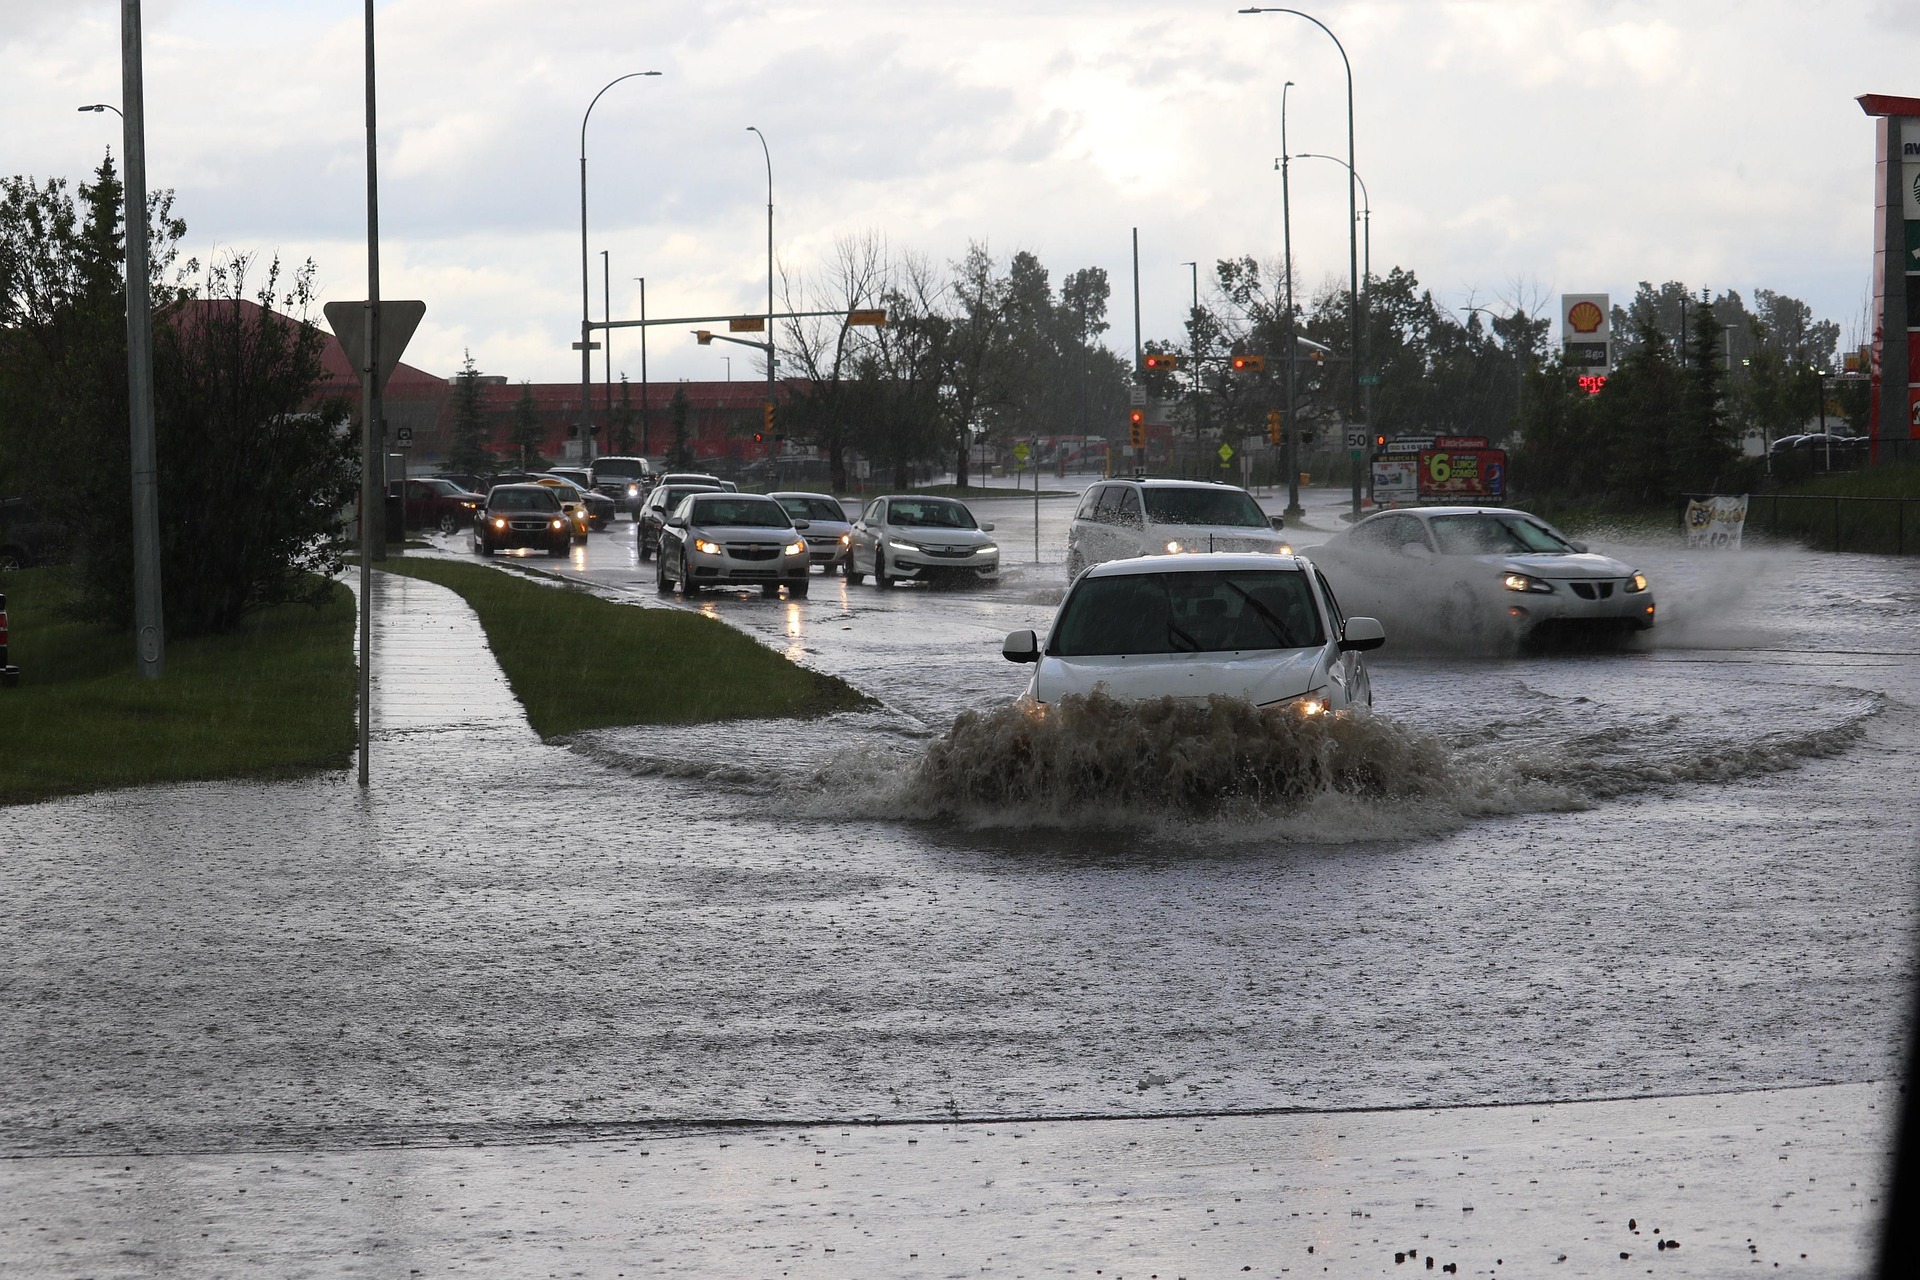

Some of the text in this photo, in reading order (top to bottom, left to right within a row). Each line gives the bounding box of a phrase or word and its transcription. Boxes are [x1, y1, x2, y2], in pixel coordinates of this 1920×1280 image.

[1348, 434, 1366, 447] 50
[1452, 460, 1477, 468] LUNCH
[1451, 469, 1478, 478] COMBO
